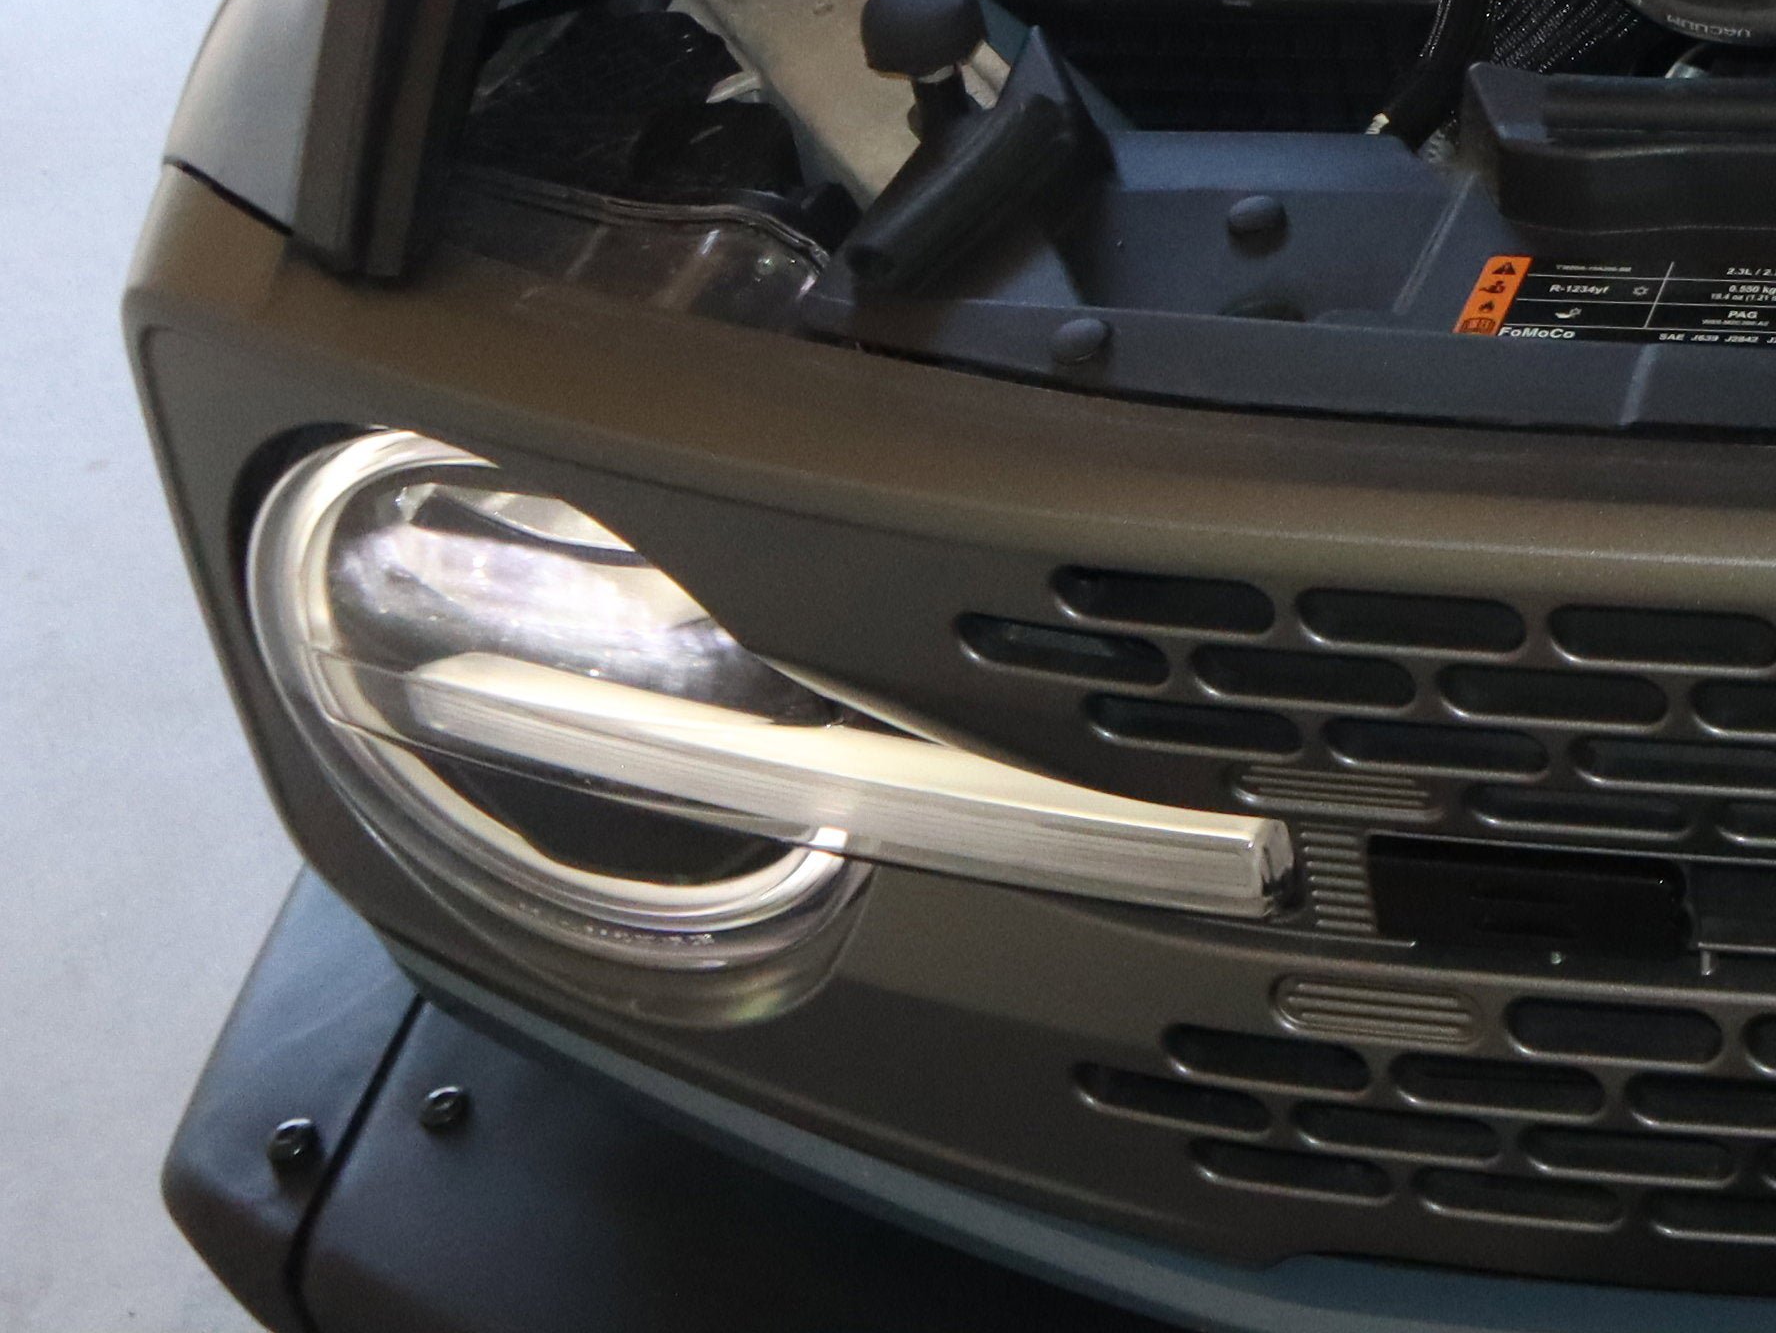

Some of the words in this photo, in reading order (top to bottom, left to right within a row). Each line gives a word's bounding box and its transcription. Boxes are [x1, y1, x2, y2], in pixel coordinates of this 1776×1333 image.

[1726, 266, 1752, 276] 2.3L
[1548, 283, 1610, 294] R-1234yf
[1727, 310, 1758, 319] PAG
[1498, 326, 1576, 339] FoMoCo
[1658, 333, 1686, 342] SAE
